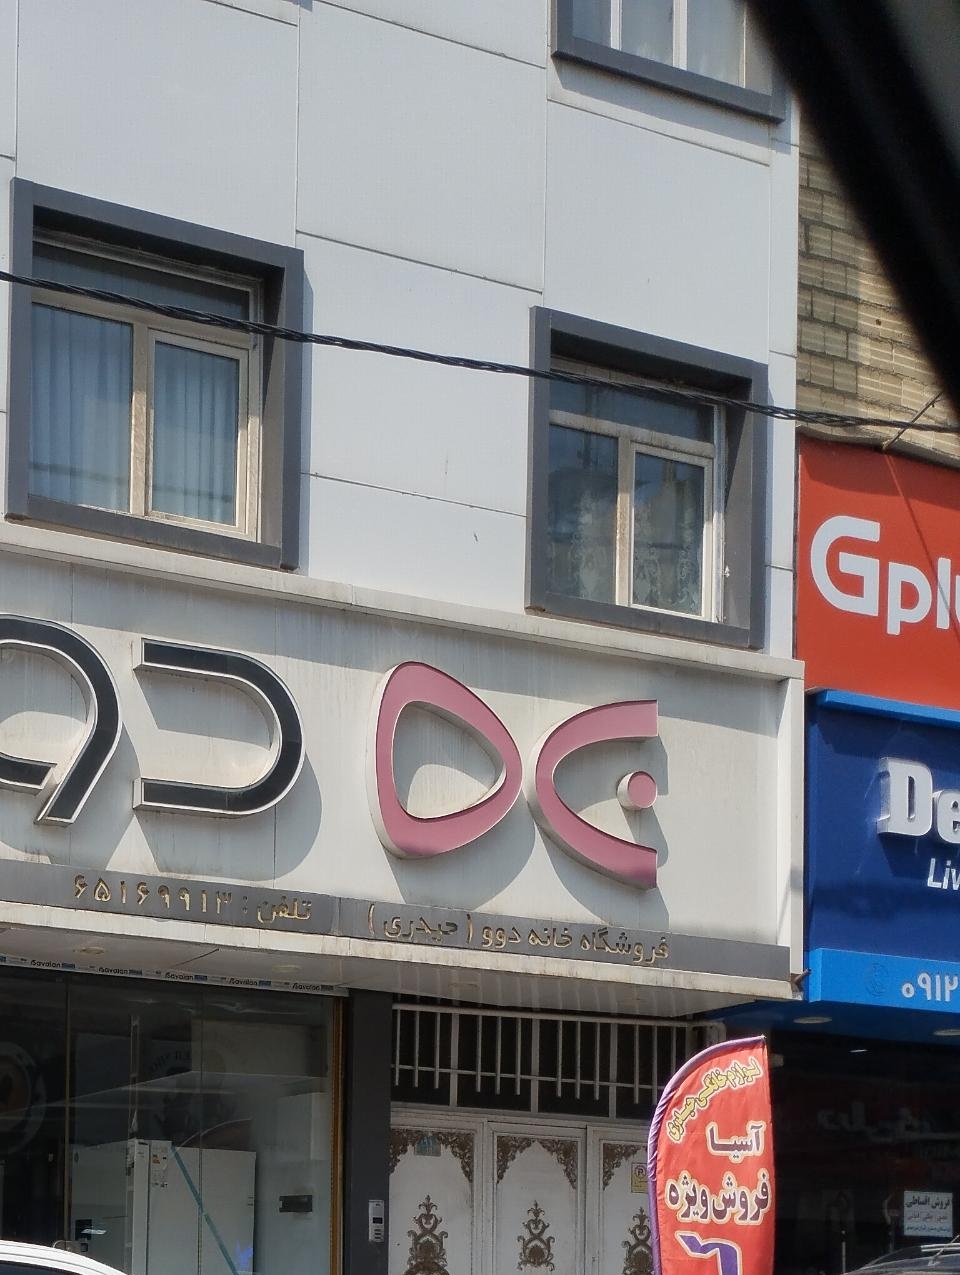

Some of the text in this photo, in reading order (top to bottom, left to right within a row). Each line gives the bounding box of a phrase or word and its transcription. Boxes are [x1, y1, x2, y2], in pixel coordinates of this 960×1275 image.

[811, 515, 960, 636] Gpl
[481, 926, 521, 949] دوو
[527, 926, 573, 949] خانه
[580, 928, 670, 964] فروشگاه
[709, 1124, 763, 1160] آسیا
[668, 1172, 769, 1221] فروش ویژه
